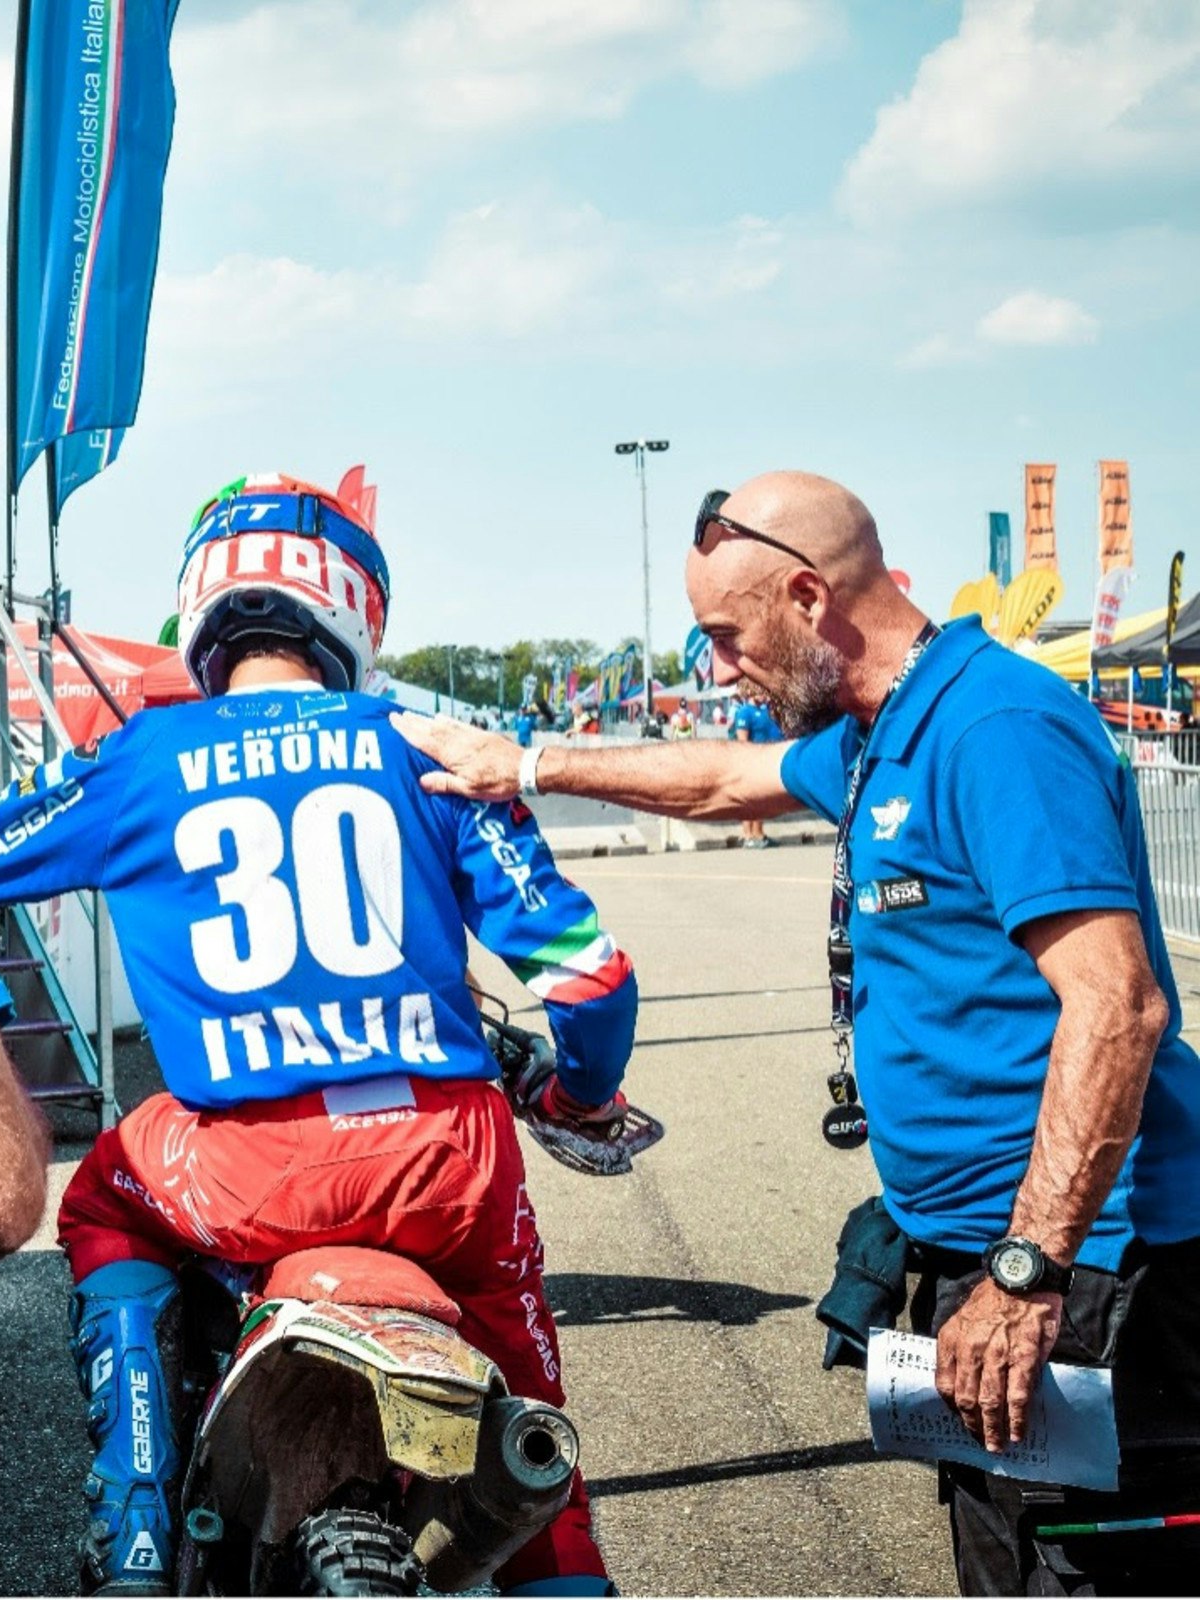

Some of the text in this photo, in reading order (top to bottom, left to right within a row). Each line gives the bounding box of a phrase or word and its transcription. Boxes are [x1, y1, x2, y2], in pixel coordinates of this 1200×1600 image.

[53, 0, 106, 411] Federazione Motociclistica Italia
[179, 729, 383, 793] VERONA
[243, 720, 319, 742] ANDREA
[174, 783, 405, 994] 30
[201, 993, 450, 1082] ITALIA
